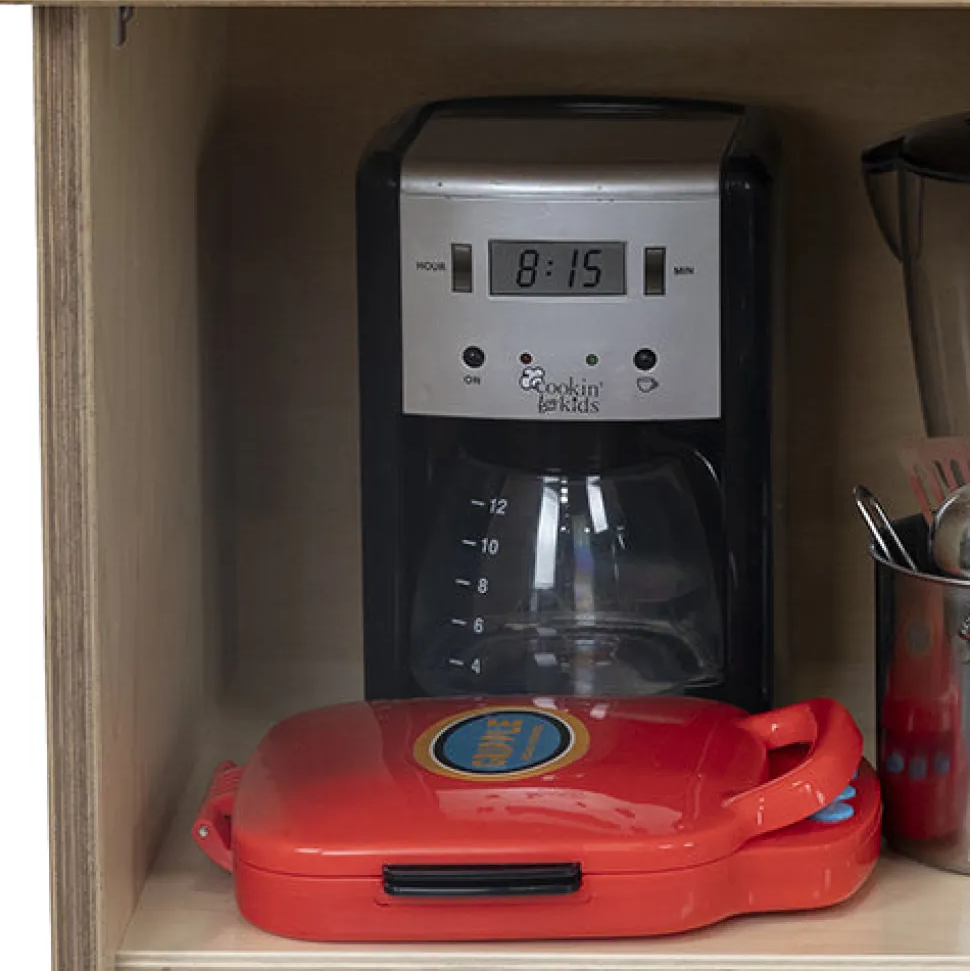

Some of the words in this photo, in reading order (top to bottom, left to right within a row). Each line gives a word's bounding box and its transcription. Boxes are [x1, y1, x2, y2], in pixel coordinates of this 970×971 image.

[416, 261, 447, 271] HOUR
[516, 249, 602, 288] 8:15
[673, 265, 695, 275] MIN
[463, 376, 481, 385] ON
[559, 395, 601, 414] kids
[489, 499, 508, 516] 12
[481, 538, 499, 555] 10
[477, 578, 489, 594] 8
[473, 617, 485, 634] 6
[471, 658, 482, 675] 4
